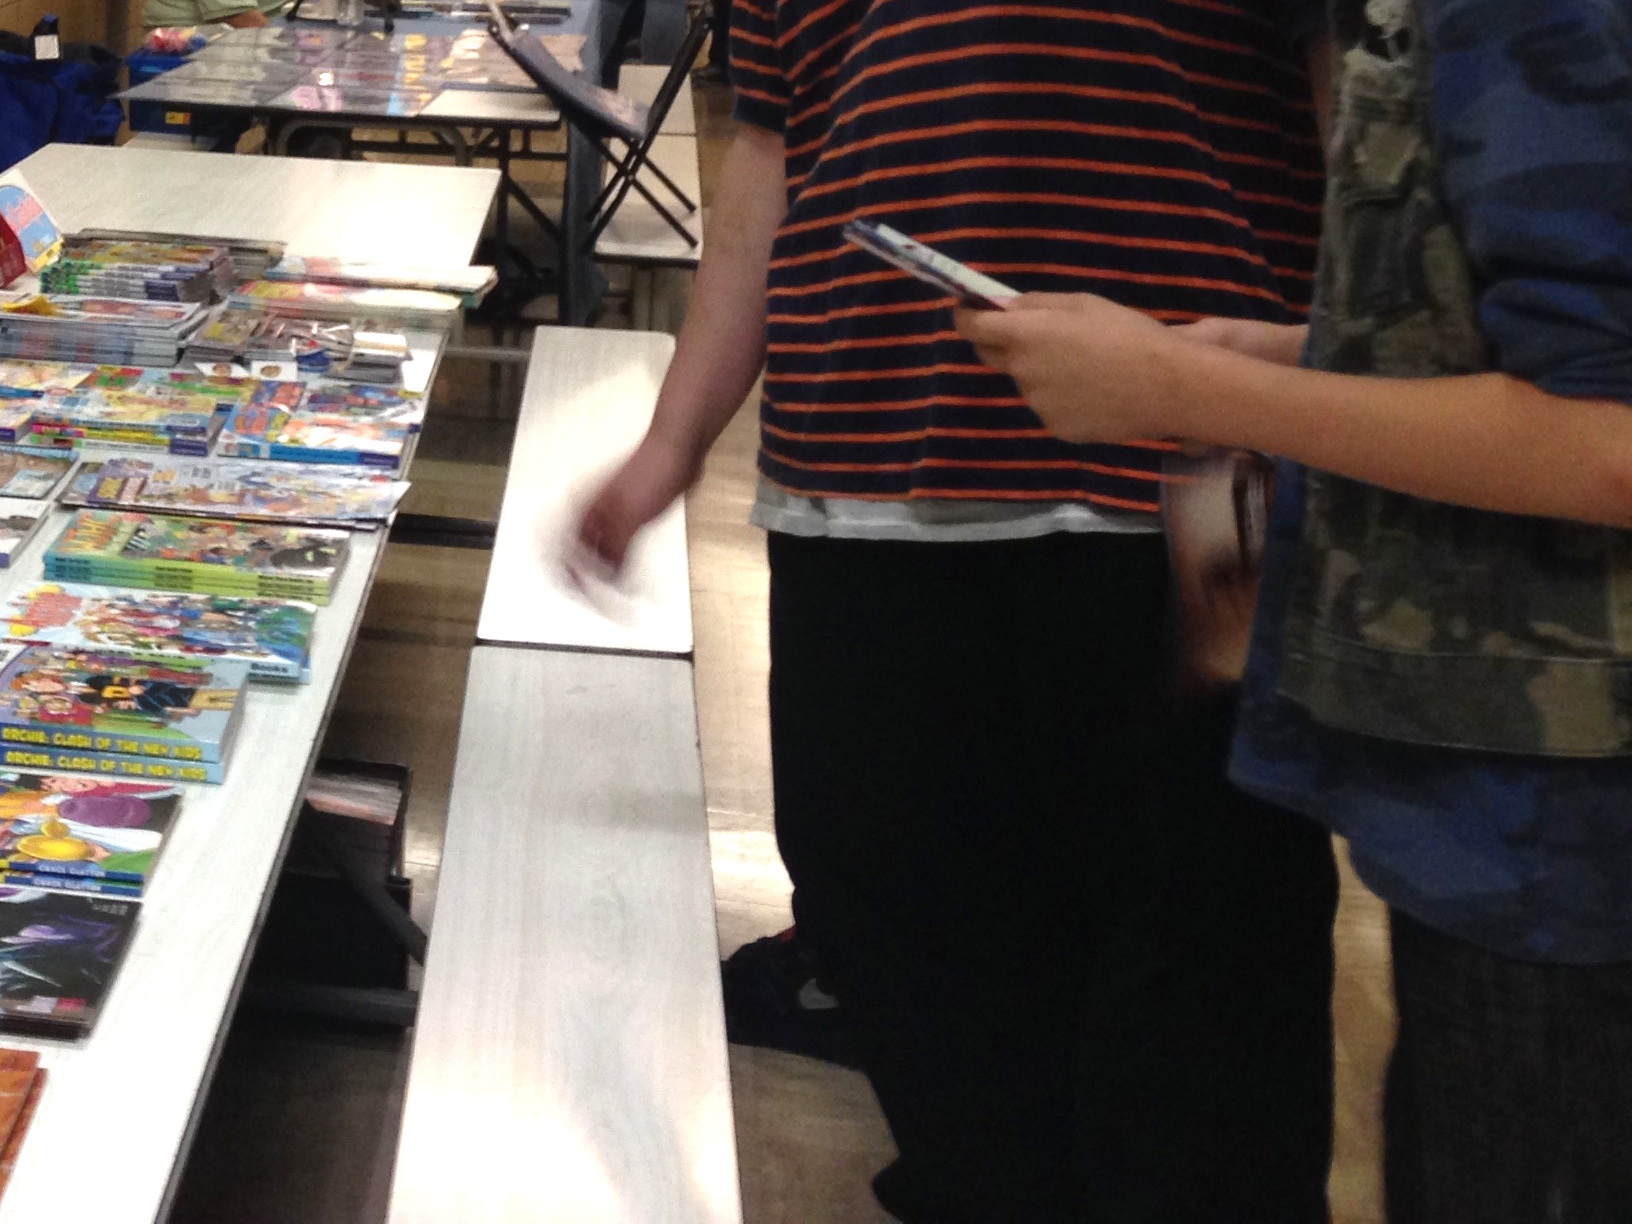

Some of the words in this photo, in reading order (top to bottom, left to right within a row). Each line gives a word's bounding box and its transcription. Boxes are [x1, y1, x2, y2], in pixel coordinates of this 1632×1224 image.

[96, 737, 112, 750] OF
[117, 739, 139, 753] THE
[101, 758, 117, 772] OF
[121, 760, 144, 775] THE
